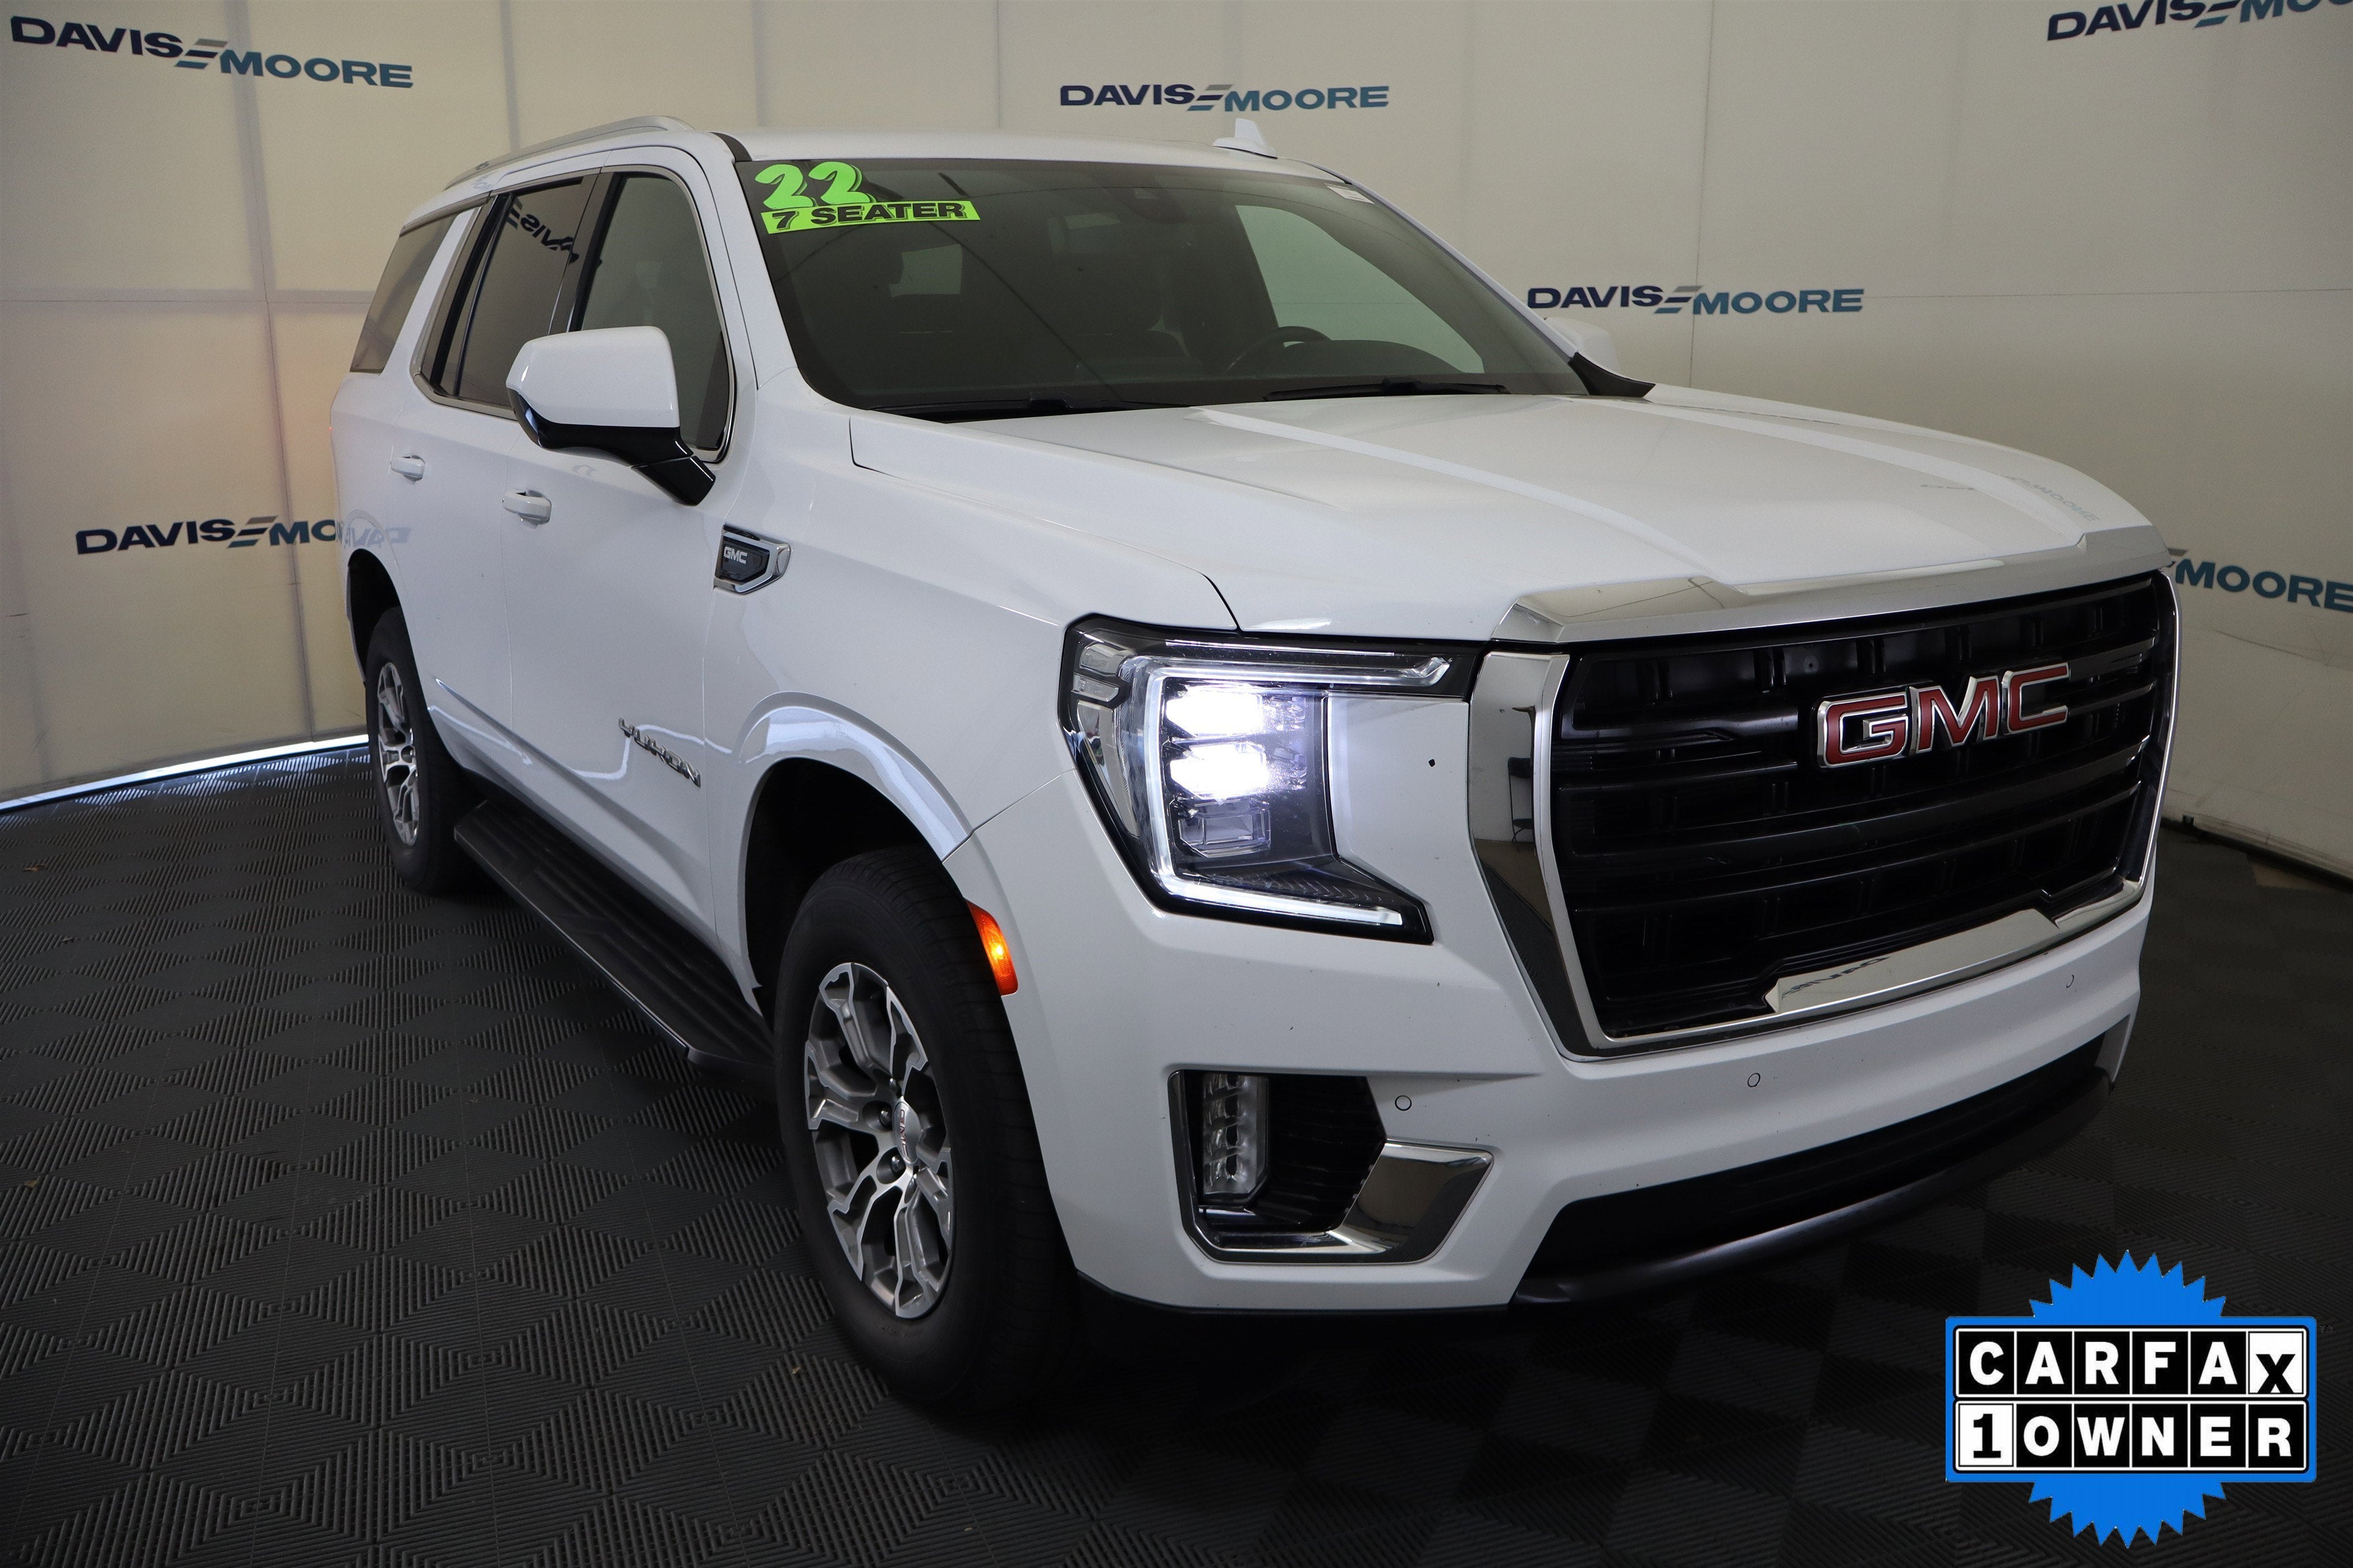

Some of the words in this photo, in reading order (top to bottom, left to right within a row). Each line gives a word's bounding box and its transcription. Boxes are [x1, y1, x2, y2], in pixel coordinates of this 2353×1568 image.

[2047, 0, 2208, 41] DAVIS
[10, 16, 183, 58] DAVIS
[219, 49, 414, 88] MOORE
[1060, 84, 1195, 106] DAVIS
[1224, 86, 1390, 112] MOORE
[755, 161, 877, 210] 22
[772, 210, 799, 230] 7
[811, 203, 968, 226] SEATER
[1527, 285, 1664, 309] DAVIS
[1693, 288, 1864, 315] MOORE
[76, 518, 236, 555] DAVIS
[724, 546, 747, 565] GMC
[1818, 662, 2070, 768] GMC
